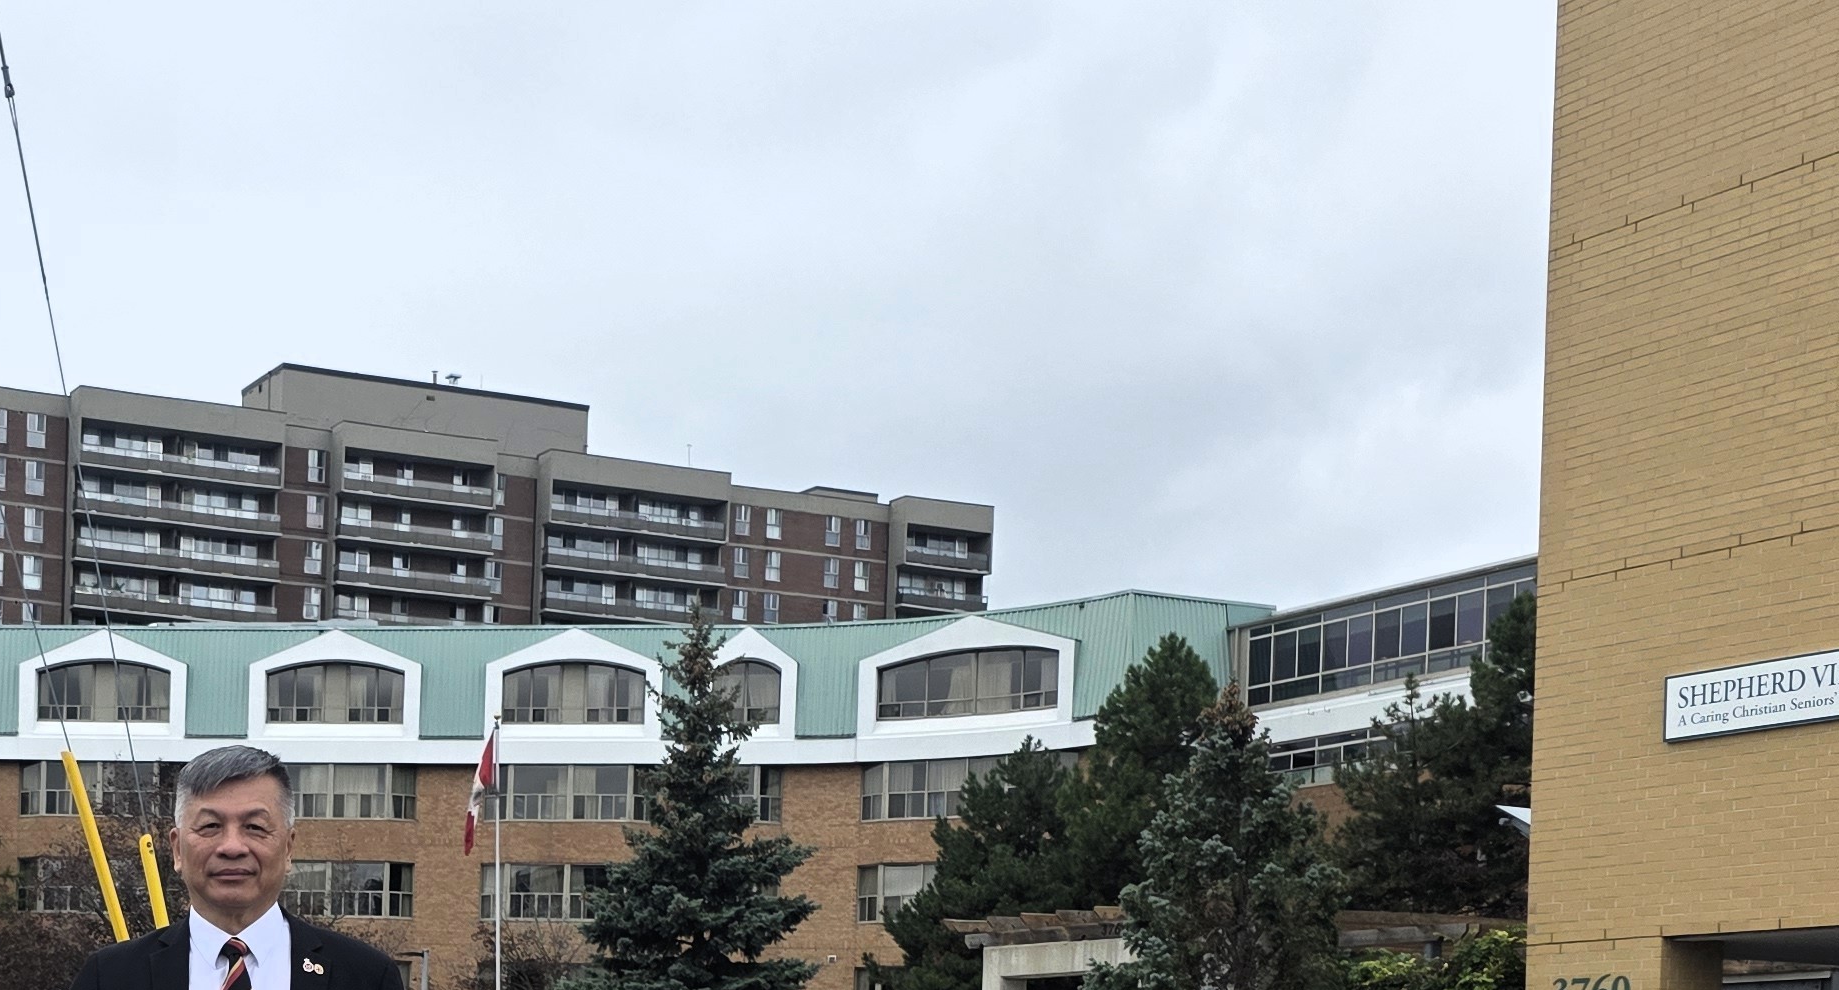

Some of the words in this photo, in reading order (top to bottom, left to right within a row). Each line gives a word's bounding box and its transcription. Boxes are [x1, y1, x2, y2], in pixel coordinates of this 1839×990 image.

[1677, 668, 1806, 709] SHEPHERD
[1811, 662, 1839, 688] VI
[1677, 714, 1687, 728] A
[1690, 711, 1729, 725] Caring
[1732, 702, 1786, 720] Christian
[1789, 691, 1838, 711] Seniors'
